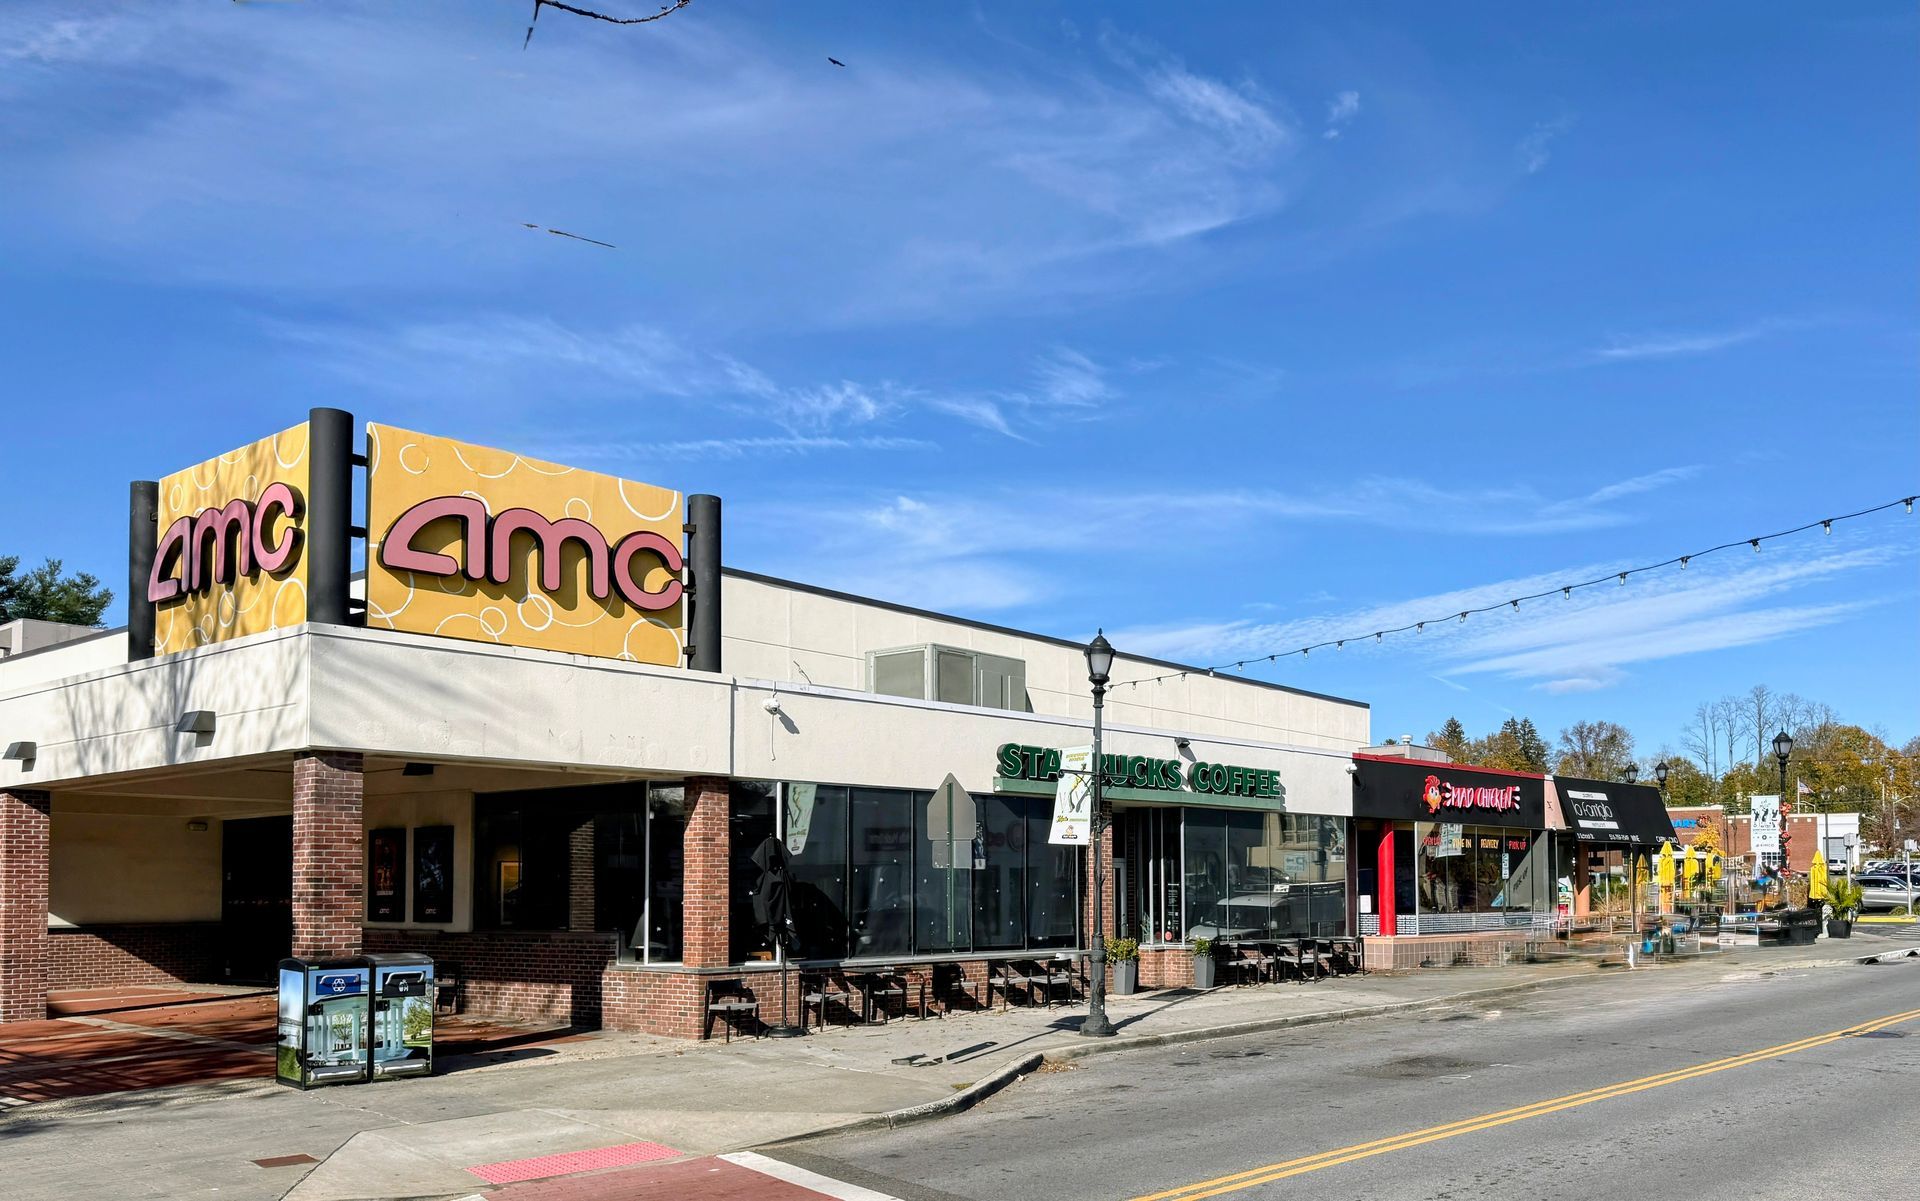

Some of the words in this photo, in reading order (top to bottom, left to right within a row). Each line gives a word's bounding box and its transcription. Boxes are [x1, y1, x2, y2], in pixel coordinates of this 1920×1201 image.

[381, 495, 684, 611] amc
[998, 743, 1183, 790] STABUCKS
[1189, 761, 1281, 797] COFFEE
[1450, 786, 1474, 808] MAD
[1475, 785, 1513, 811] CHICKEN
[1671, 819, 1697, 828] ART
